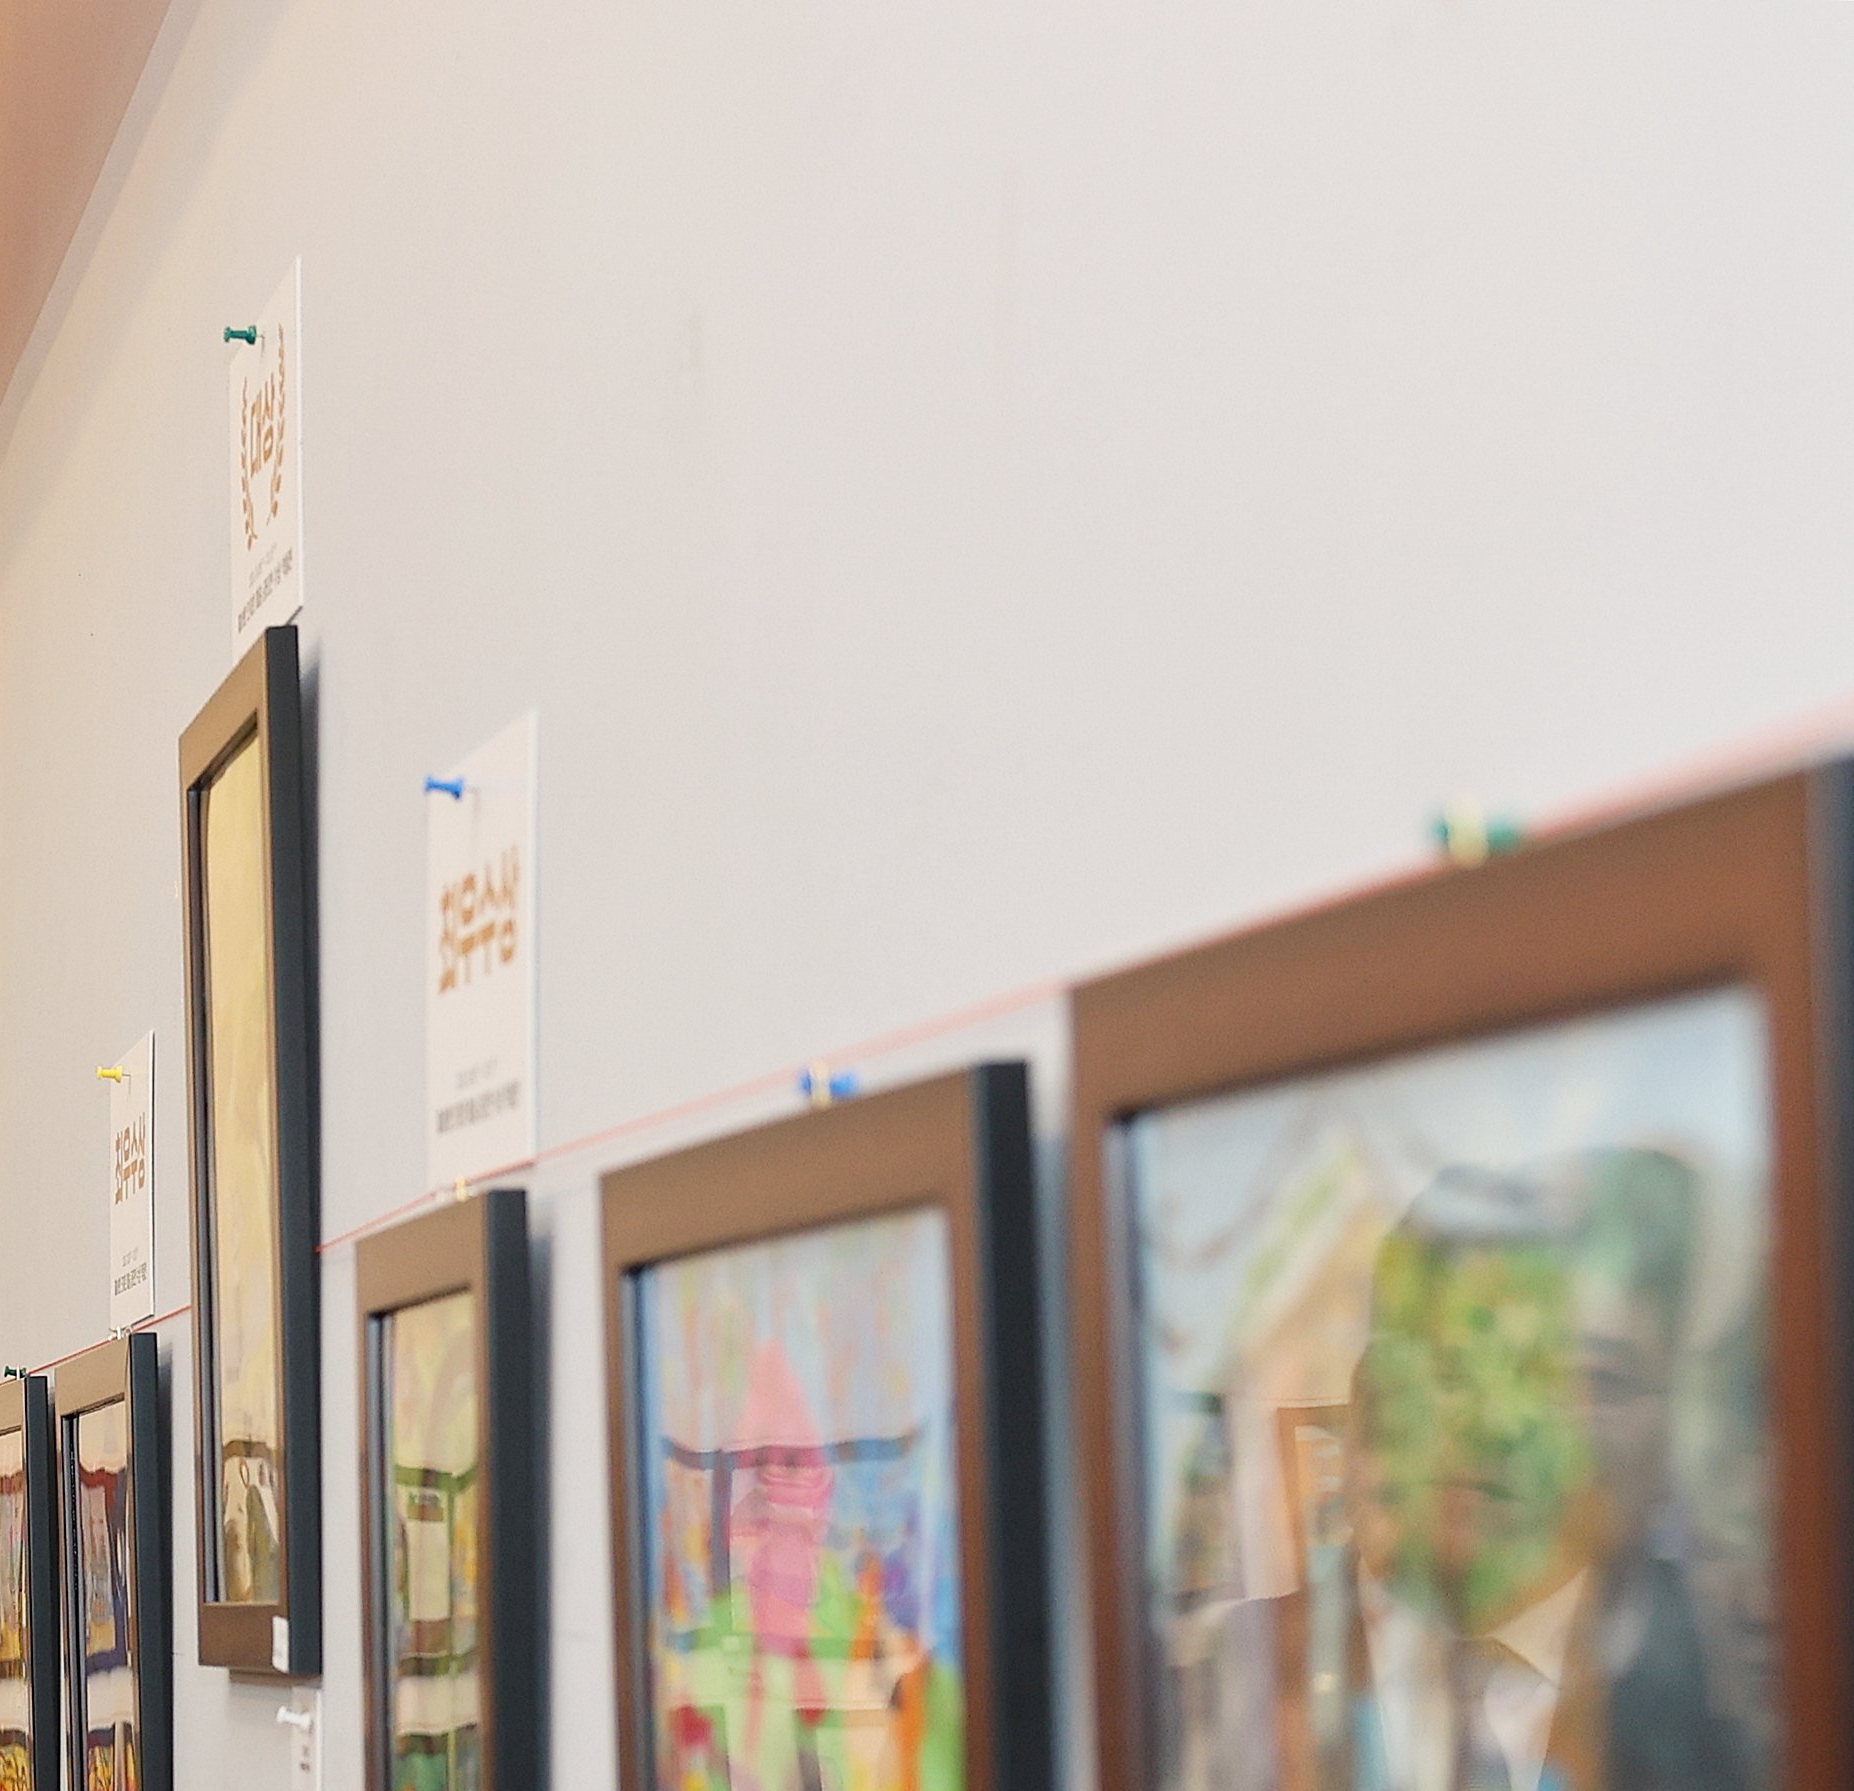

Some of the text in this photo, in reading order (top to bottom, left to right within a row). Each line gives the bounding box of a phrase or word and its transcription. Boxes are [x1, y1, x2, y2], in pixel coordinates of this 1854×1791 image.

[250, 372, 275, 478] 대상
[439, 845, 520, 994] 최우수상
[115, 1112, 146, 1205] 최우수상
